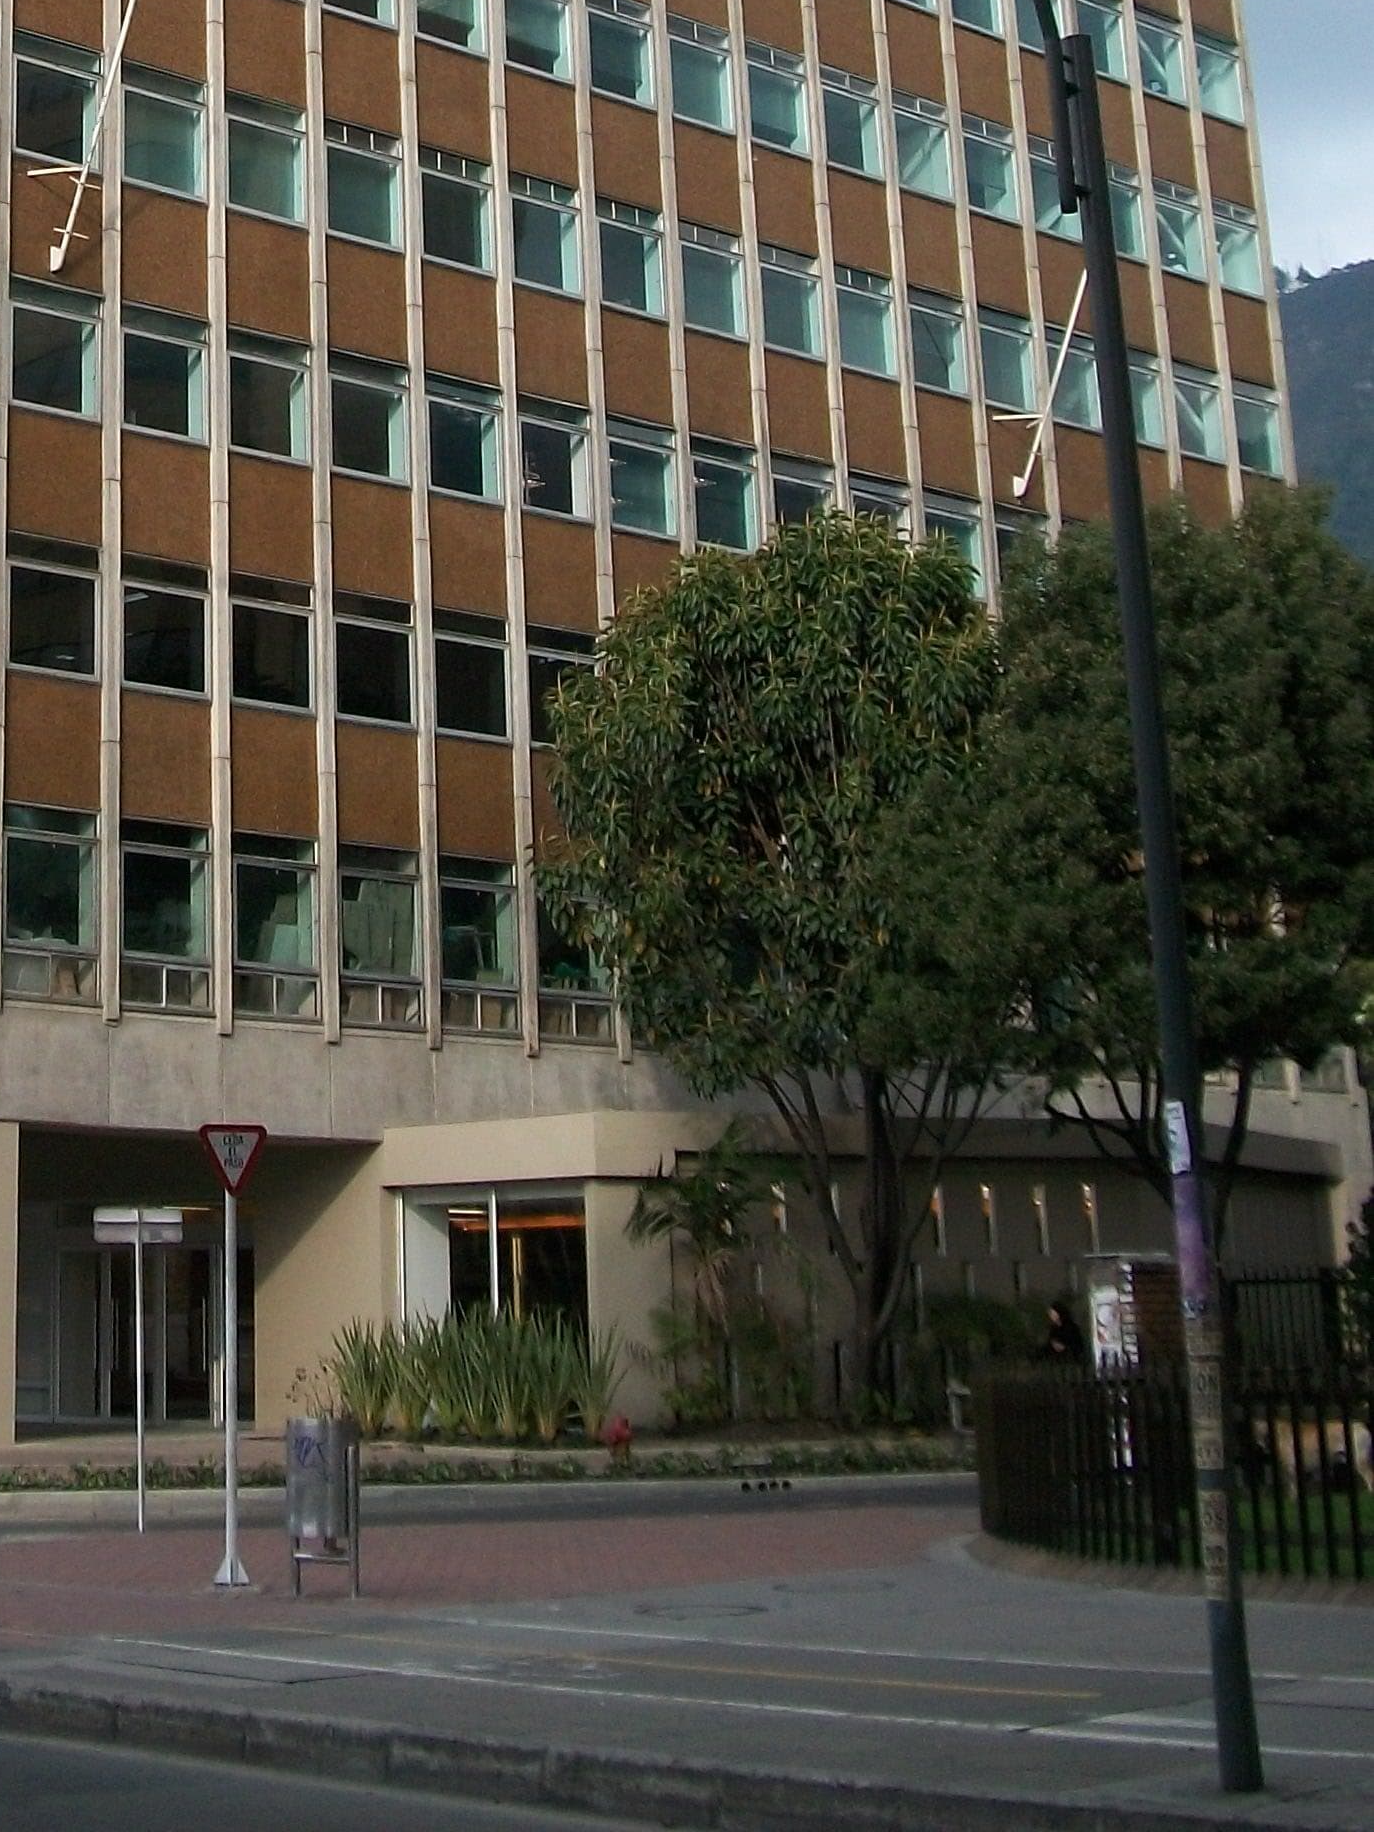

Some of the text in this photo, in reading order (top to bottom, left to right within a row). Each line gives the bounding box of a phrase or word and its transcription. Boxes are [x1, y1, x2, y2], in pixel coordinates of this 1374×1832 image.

[223, 1135, 244, 1145] CEDA
[228, 1147, 236, 1156] EL
[224, 1159, 244, 1168] PASO
